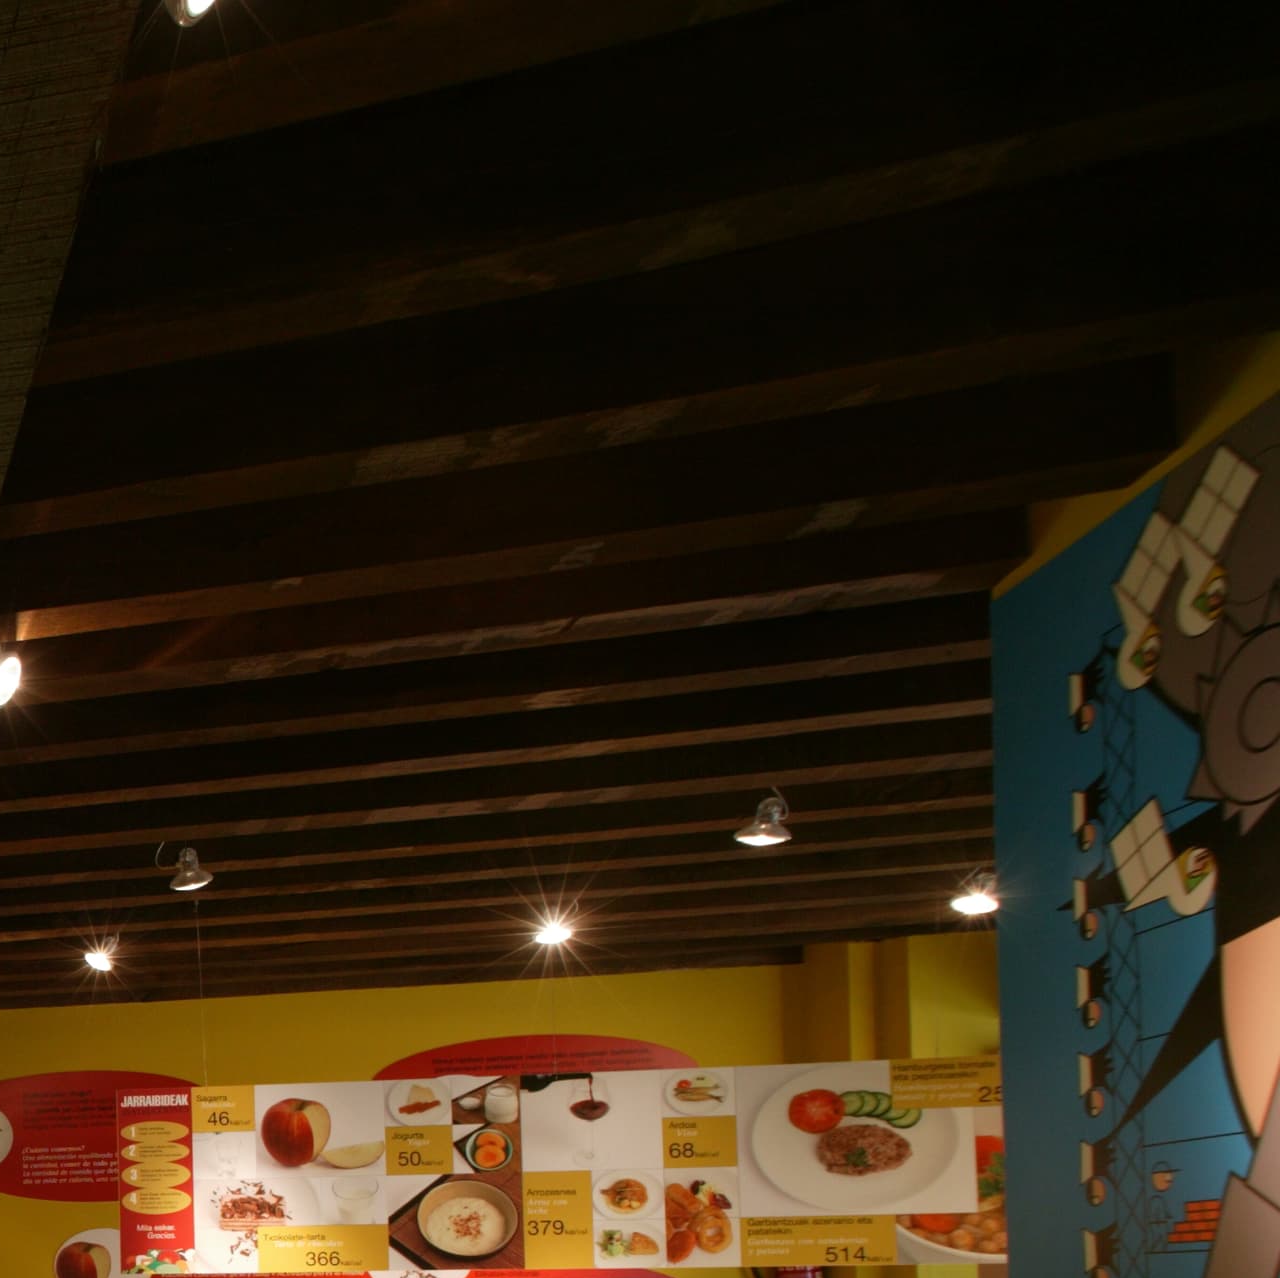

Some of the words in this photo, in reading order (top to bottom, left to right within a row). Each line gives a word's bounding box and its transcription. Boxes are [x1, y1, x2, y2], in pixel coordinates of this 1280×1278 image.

[120, 1094, 189, 1109] JARRAIBIDEAK
[196, 1095, 228, 1105] Sagarra
[207, 1111, 230, 1126] 46
[129, 1127, 136, 1138] 1
[128, 1145, 136, 1157] 2
[668, 1143, 695, 1159] 68
[397, 1151, 422, 1167] 50
[527, 1220, 565, 1236] 379
[305, 1250, 341, 1267] 366
[825, 1246, 866, 1263] 514
